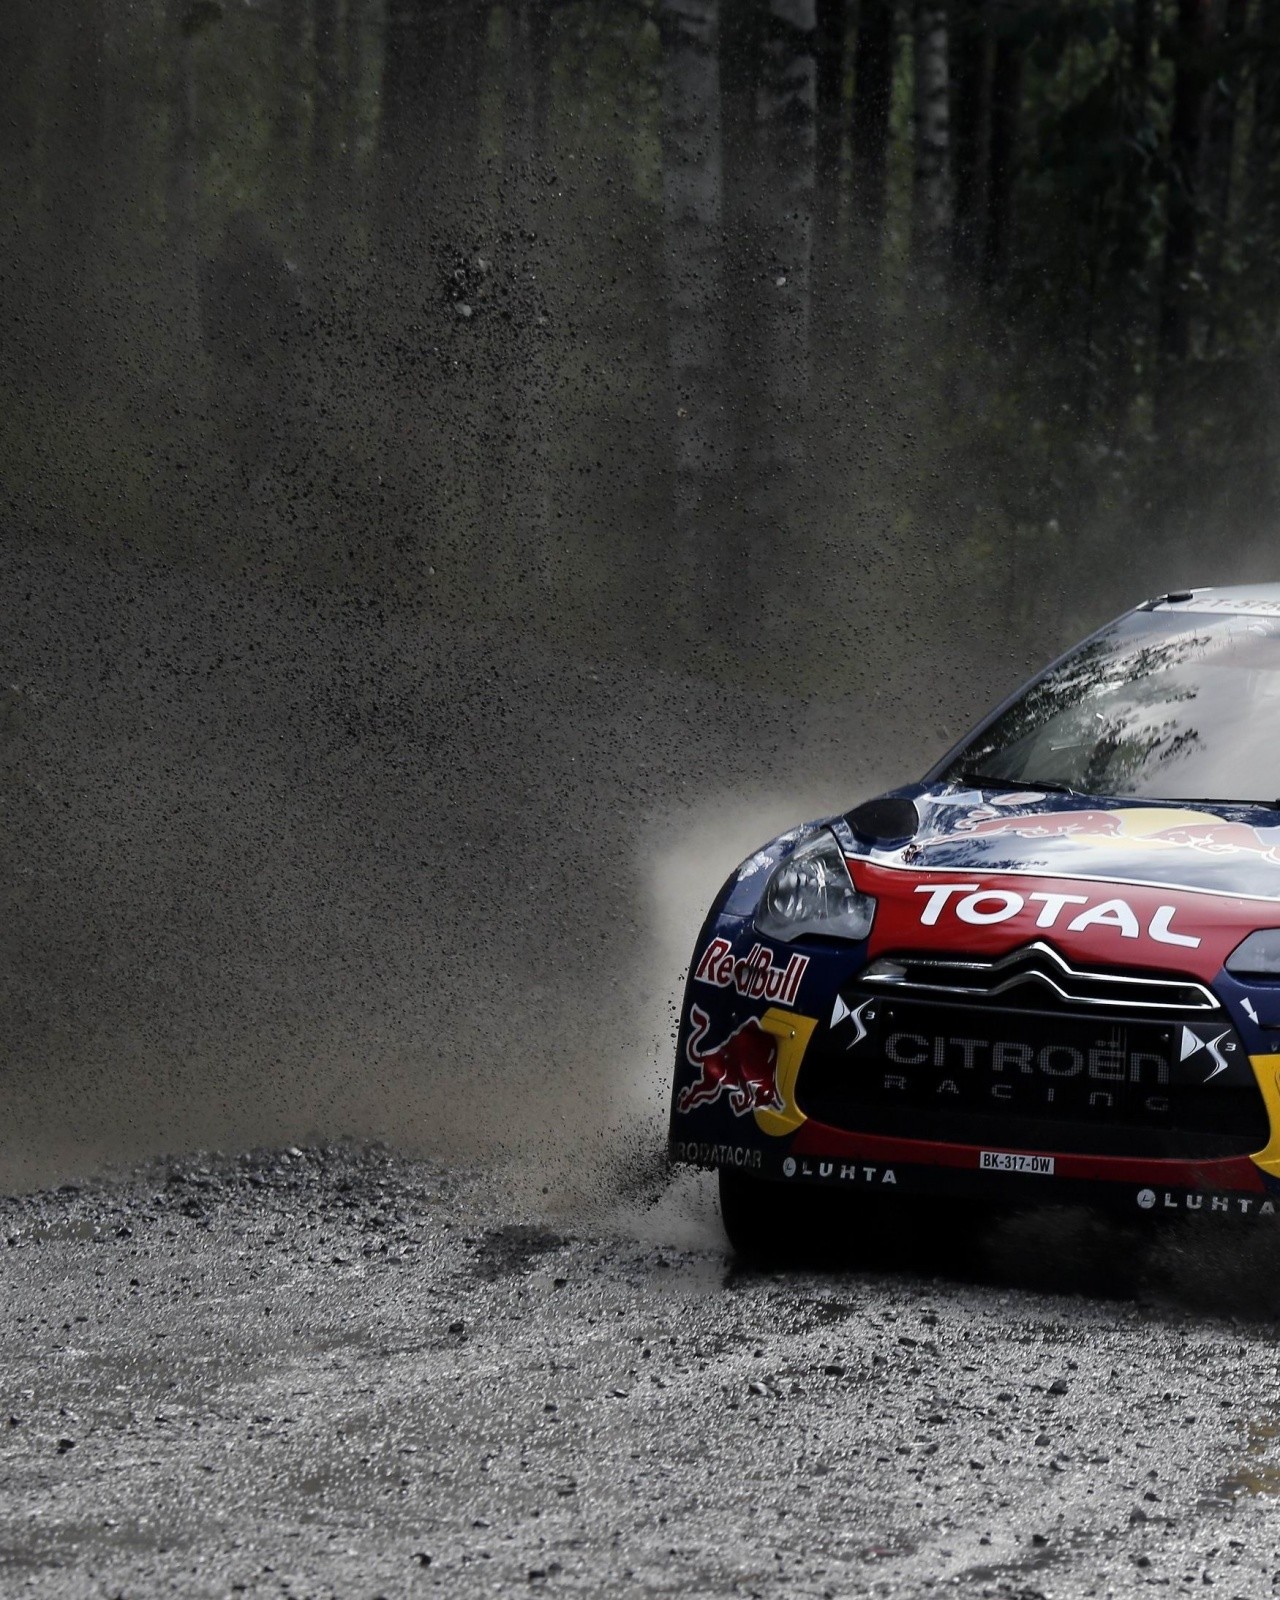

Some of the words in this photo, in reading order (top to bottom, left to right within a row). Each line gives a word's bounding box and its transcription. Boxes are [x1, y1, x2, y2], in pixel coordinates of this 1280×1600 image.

[914, 884, 1201, 948] TOTAL
[673, 1141, 762, 1169] RODATACAR
[983, 1153, 1051, 1172] BK-317-DW
[803, 1160, 897, 1184] LUHTA
[1164, 1193, 1275, 1214] LUHTA
